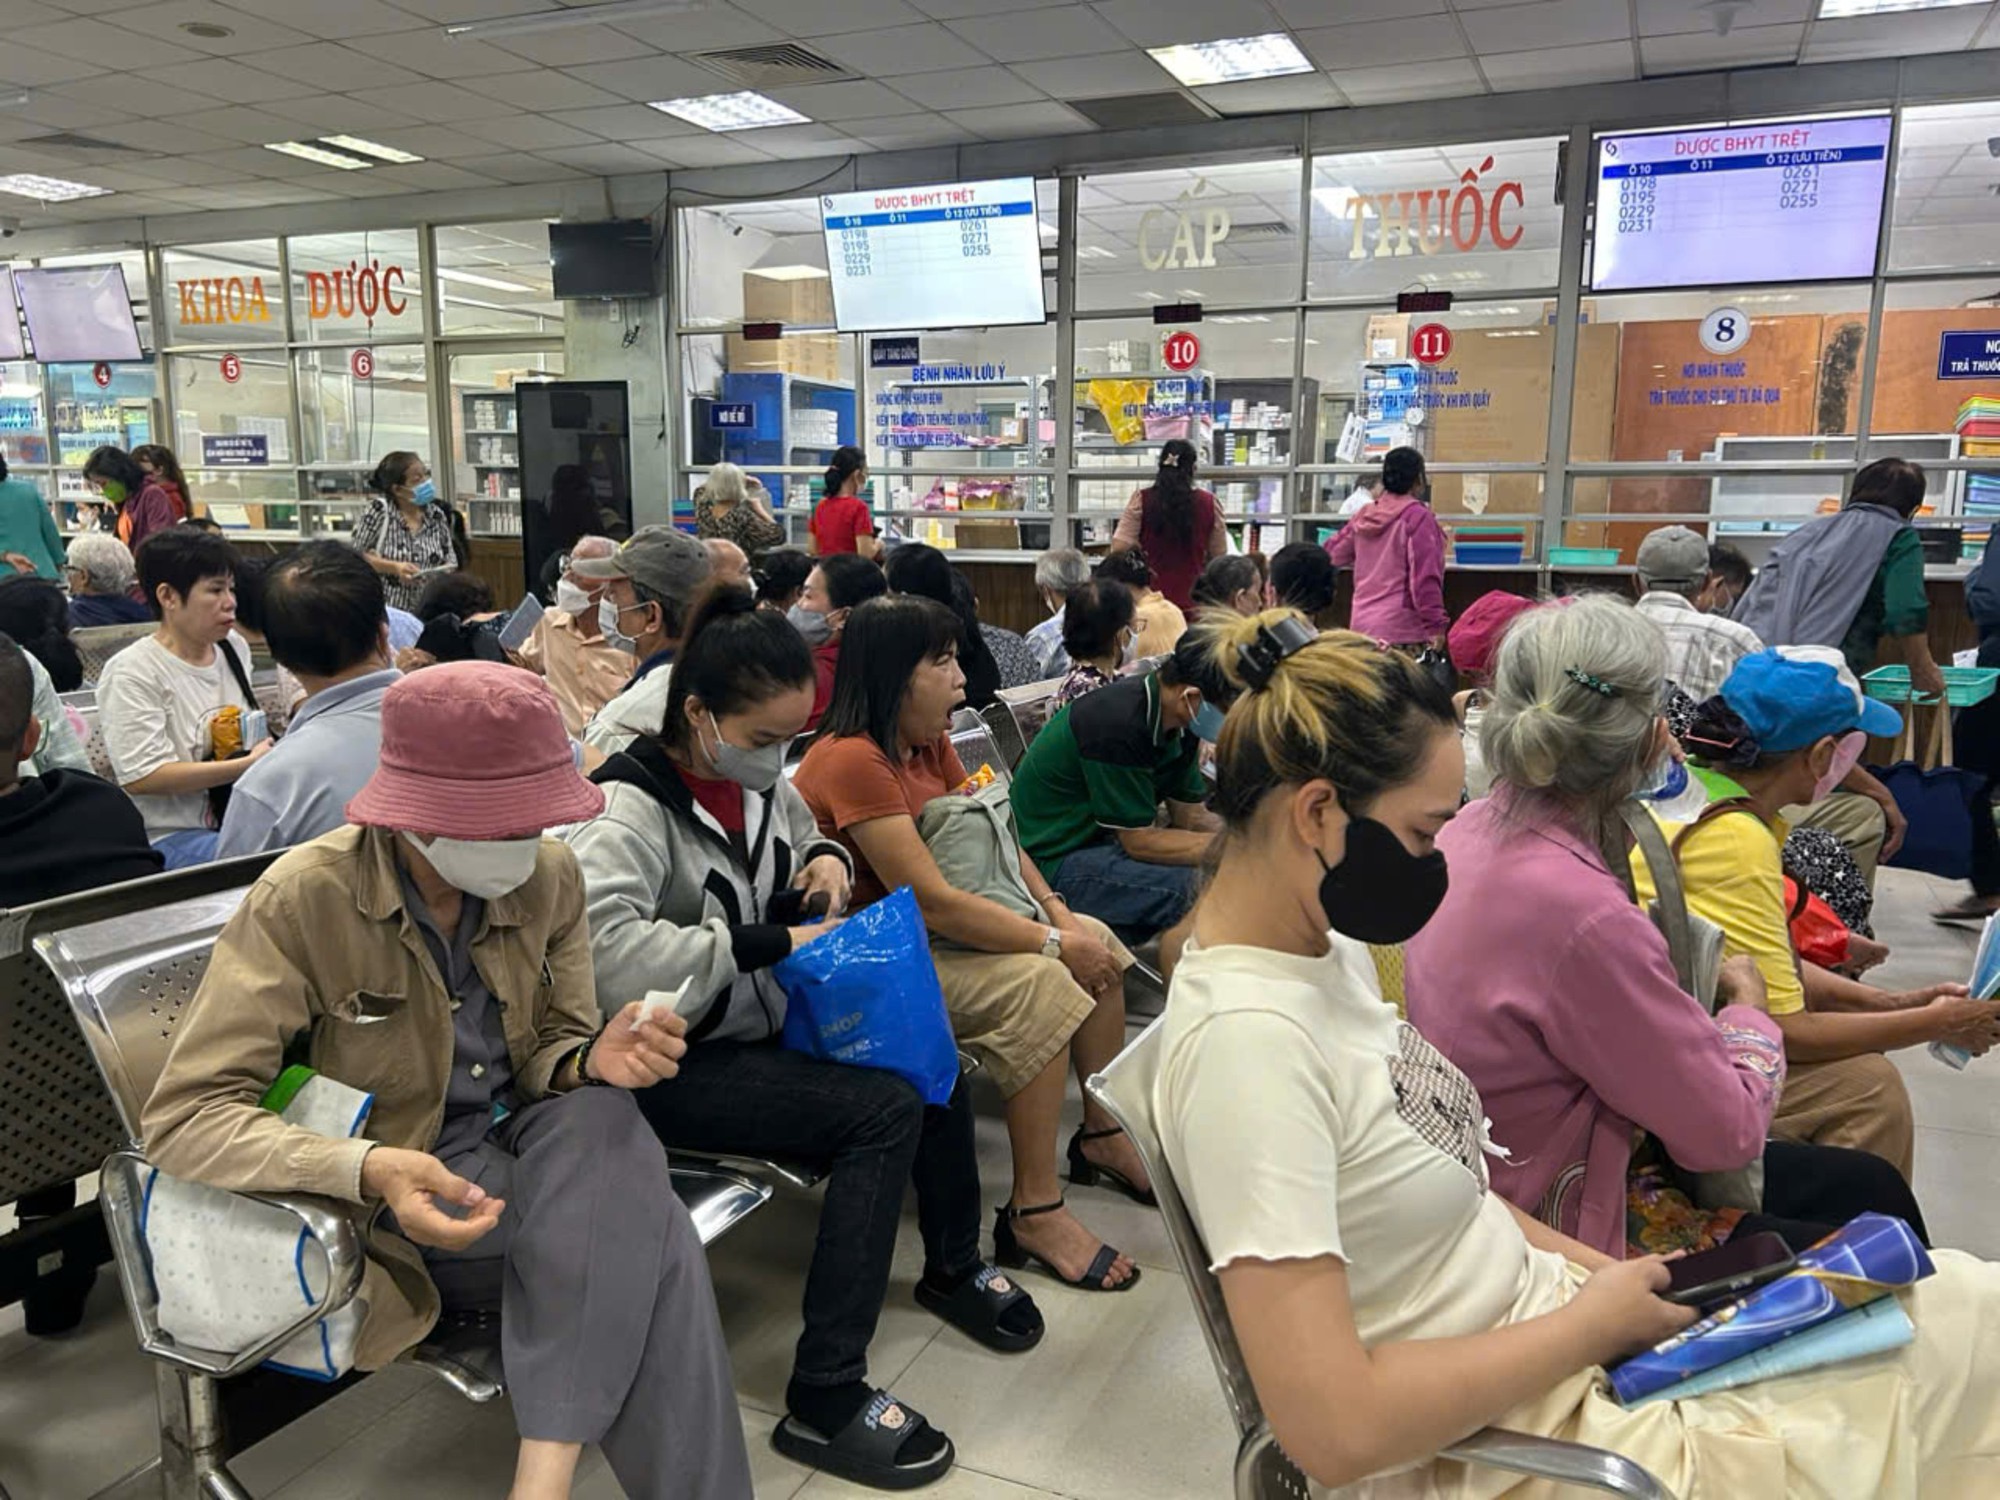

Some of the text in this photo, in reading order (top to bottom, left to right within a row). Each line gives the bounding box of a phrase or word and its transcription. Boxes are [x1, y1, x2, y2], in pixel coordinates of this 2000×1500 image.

[1674, 131, 1811, 155] DƯỢC BHYT TRỆT
[1701, 160, 1712, 170] 11
[1777, 154, 1788, 164] 12
[1639, 164, 1650, 174] 10
[1782, 165, 1820, 180] 0261
[1621, 177, 1657, 190] 0198
[1781, 180, 1818, 193] 0271
[874, 195, 908, 210] DƯỢC
[911, 192, 943, 207] BHYT
[1620, 191, 1656, 204] 0195
[1779, 195, 1818, 209] 0255
[953, 209, 963, 219] 12
[1345, 155, 1525, 260] THUỐC
[1619, 205, 1655, 218] 0229
[852, 216, 862, 226] 10
[897, 214, 906, 223] 11
[1136, 176, 1231, 271] CẤP
[960, 220, 987, 231] 0261
[1618, 220, 1653, 233] 0231
[841, 229, 868, 240] 0198
[962, 232, 989, 244] 0271
[843, 241, 870, 252] 0195
[963, 245, 991, 256] 0255
[844, 253, 871, 264] 0229
[846, 265, 872, 277] 0231
[177, 258, 408, 330] KHOA DƯỢC
[1715, 317, 1736, 342] 8
[1171, 340, 1195, 363] 10
[1420, 333, 1445, 357] 11
[226, 360, 237, 376] 5
[358, 356, 369, 374] 6
[1951, 356, 2000, 372] TRẢ THUỐ
[98, 366, 108, 382] 4
[912, 366, 940, 384] BỆNH
[943, 363, 972, 381] NHÂN
[998, 361, 1006, 380] Ý
